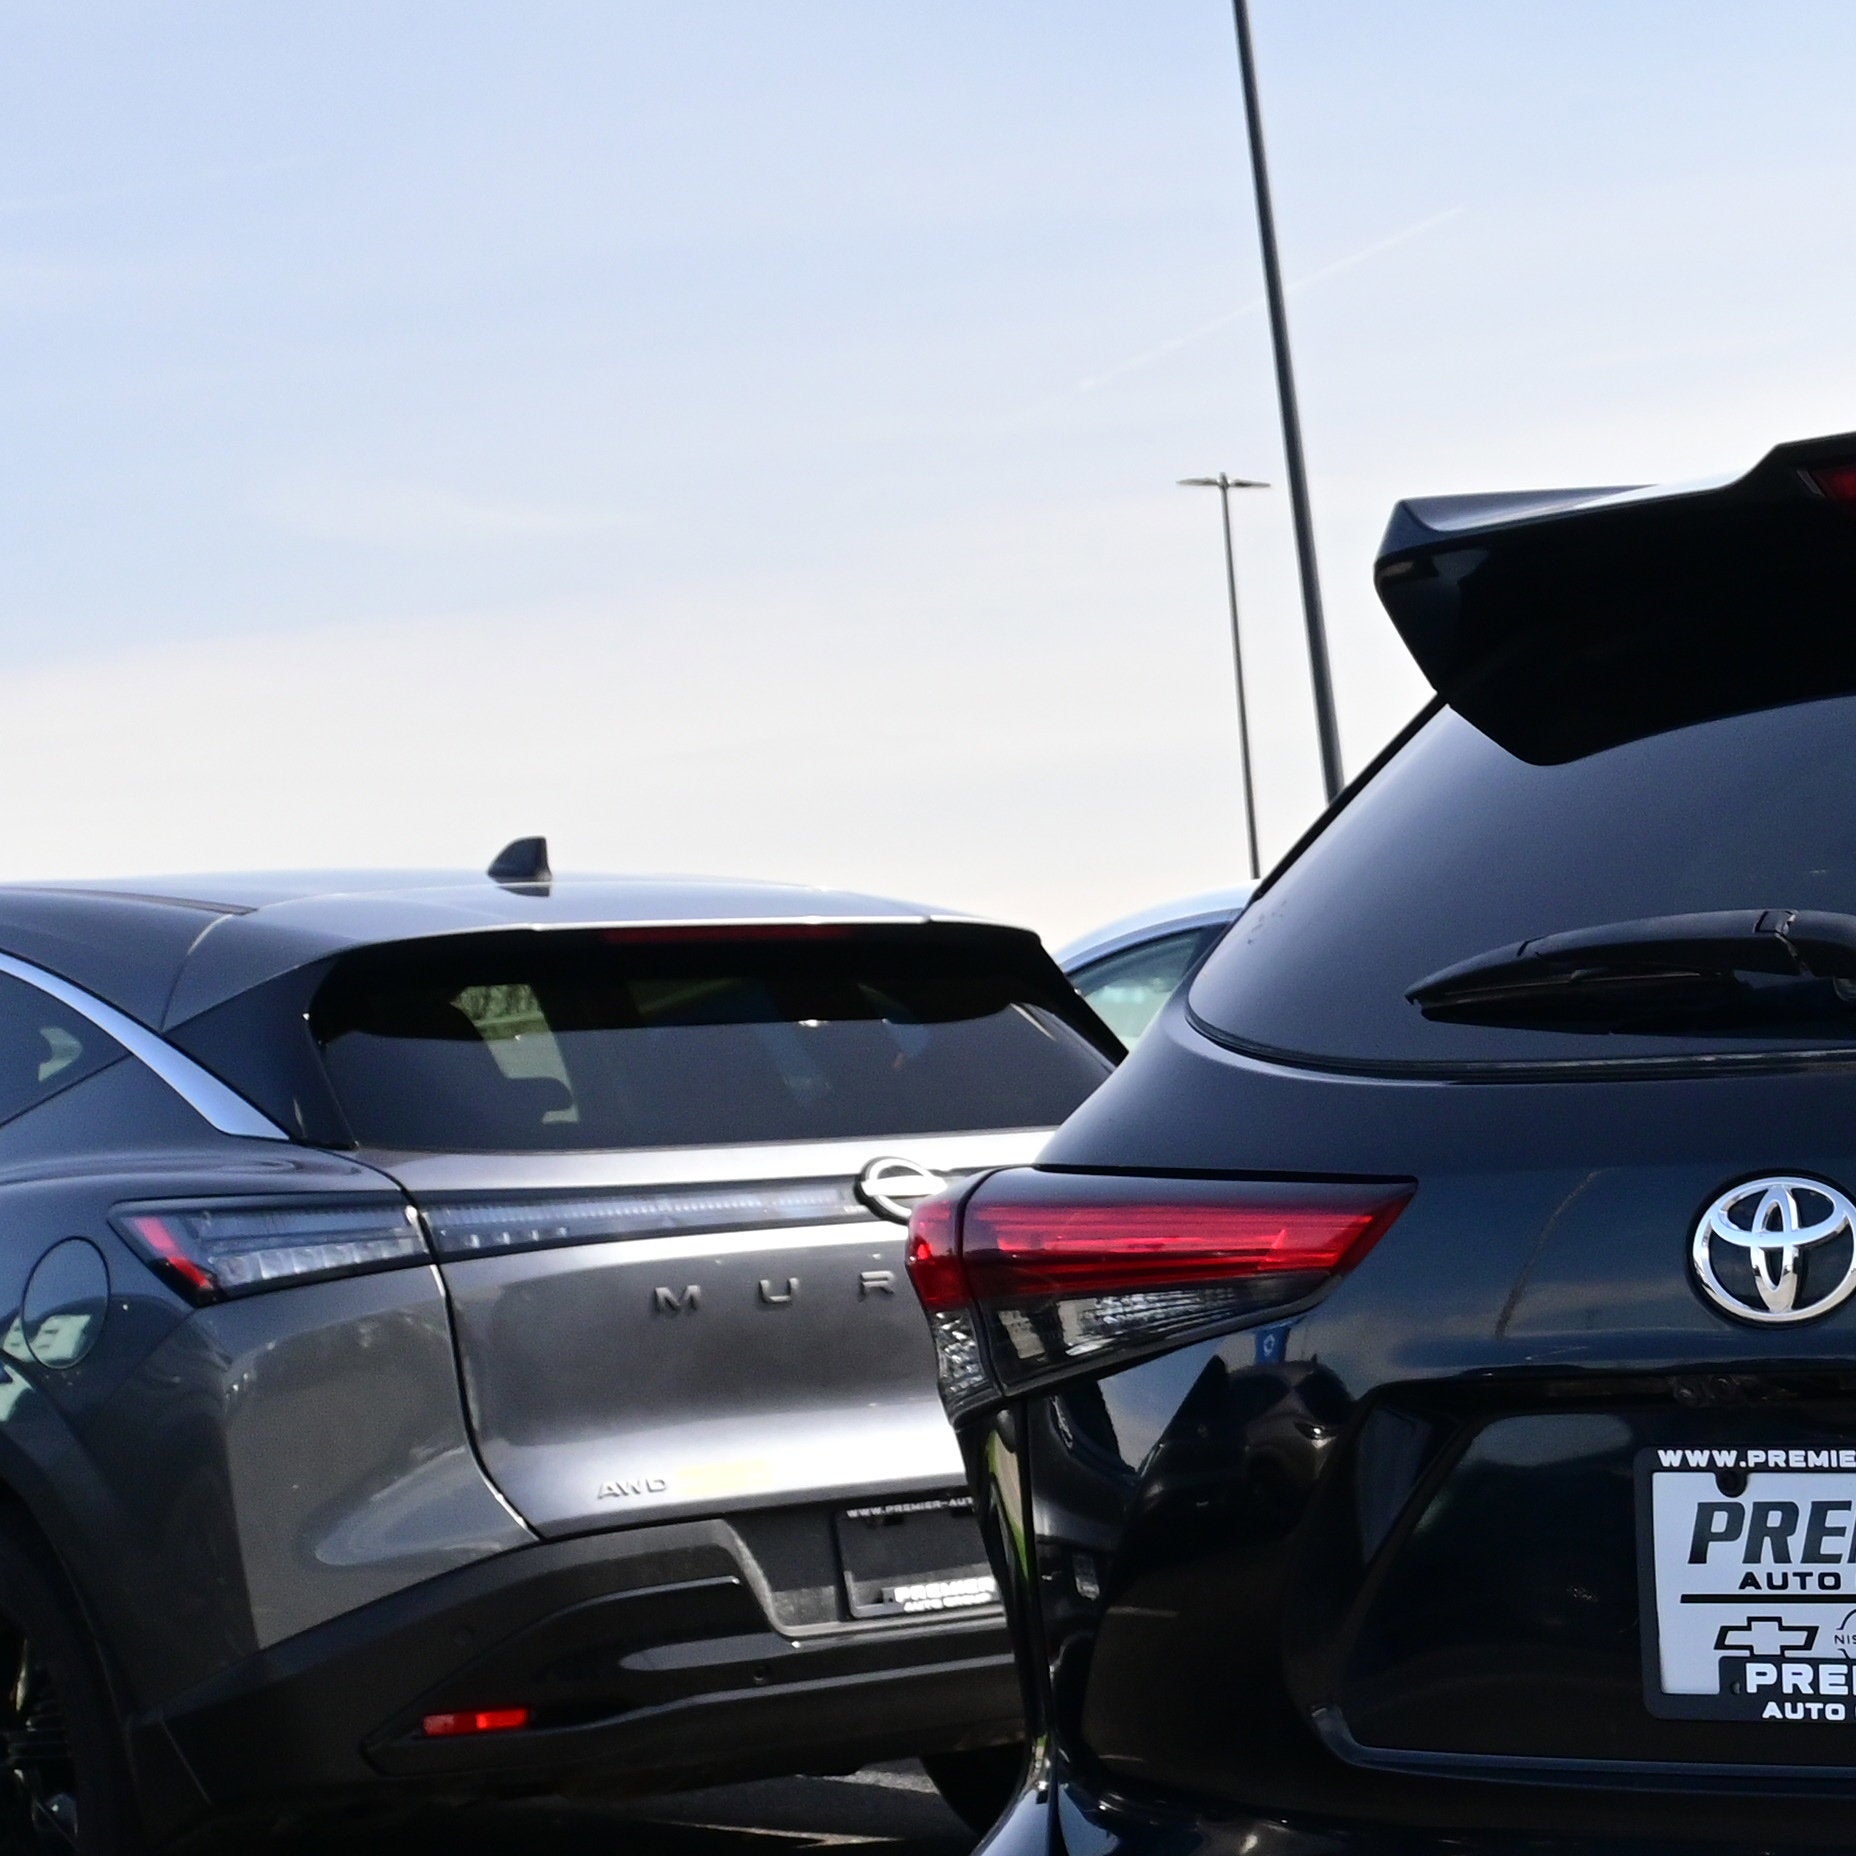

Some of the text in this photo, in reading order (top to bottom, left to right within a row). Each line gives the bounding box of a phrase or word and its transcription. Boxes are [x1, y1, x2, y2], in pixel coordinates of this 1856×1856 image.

[654, 1270, 896, 1313] MUR
[597, 1477, 668, 1501] AWD
[847, 1497, 974, 1518] WWW.PREMIER-AUT
[1738, 1572, 1841, 1590] AUTO
[1762, 1701, 1846, 1721] AUTO
